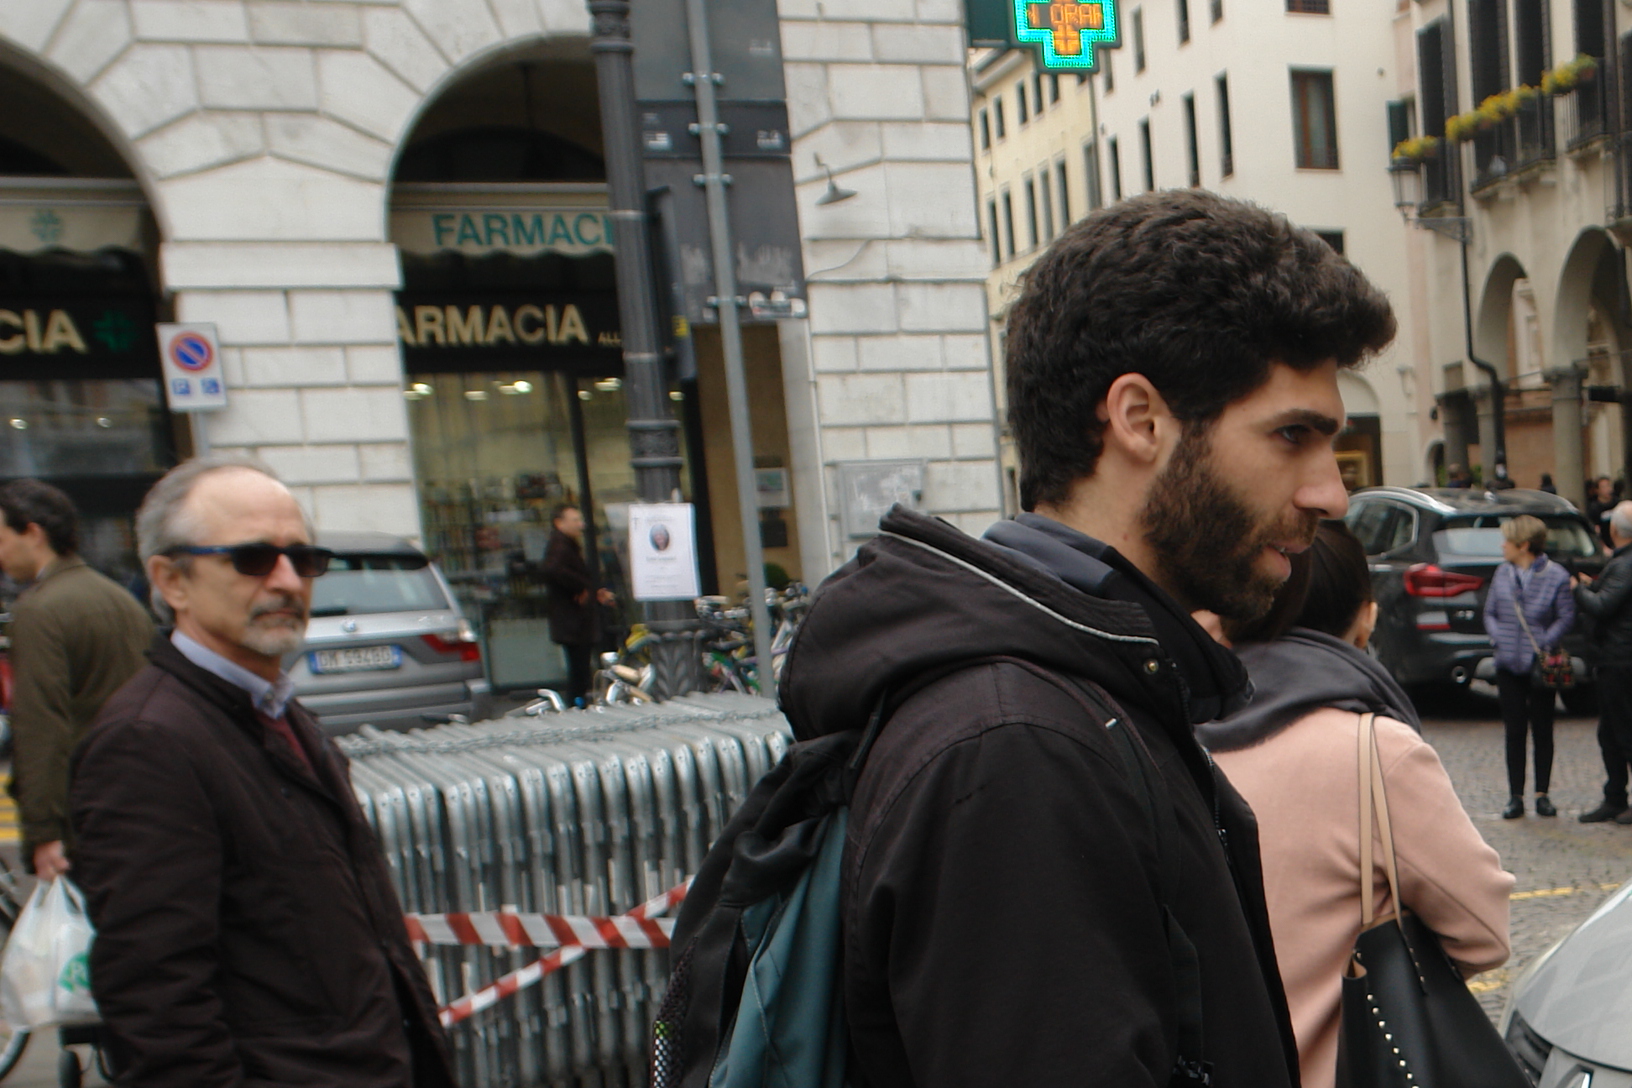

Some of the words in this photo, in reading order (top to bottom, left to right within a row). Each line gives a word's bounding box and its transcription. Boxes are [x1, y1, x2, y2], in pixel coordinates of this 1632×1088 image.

[431, 213, 616, 246] FARMACI
[0, 308, 89, 354] CIA
[397, 304, 589, 345] ARMACIA
